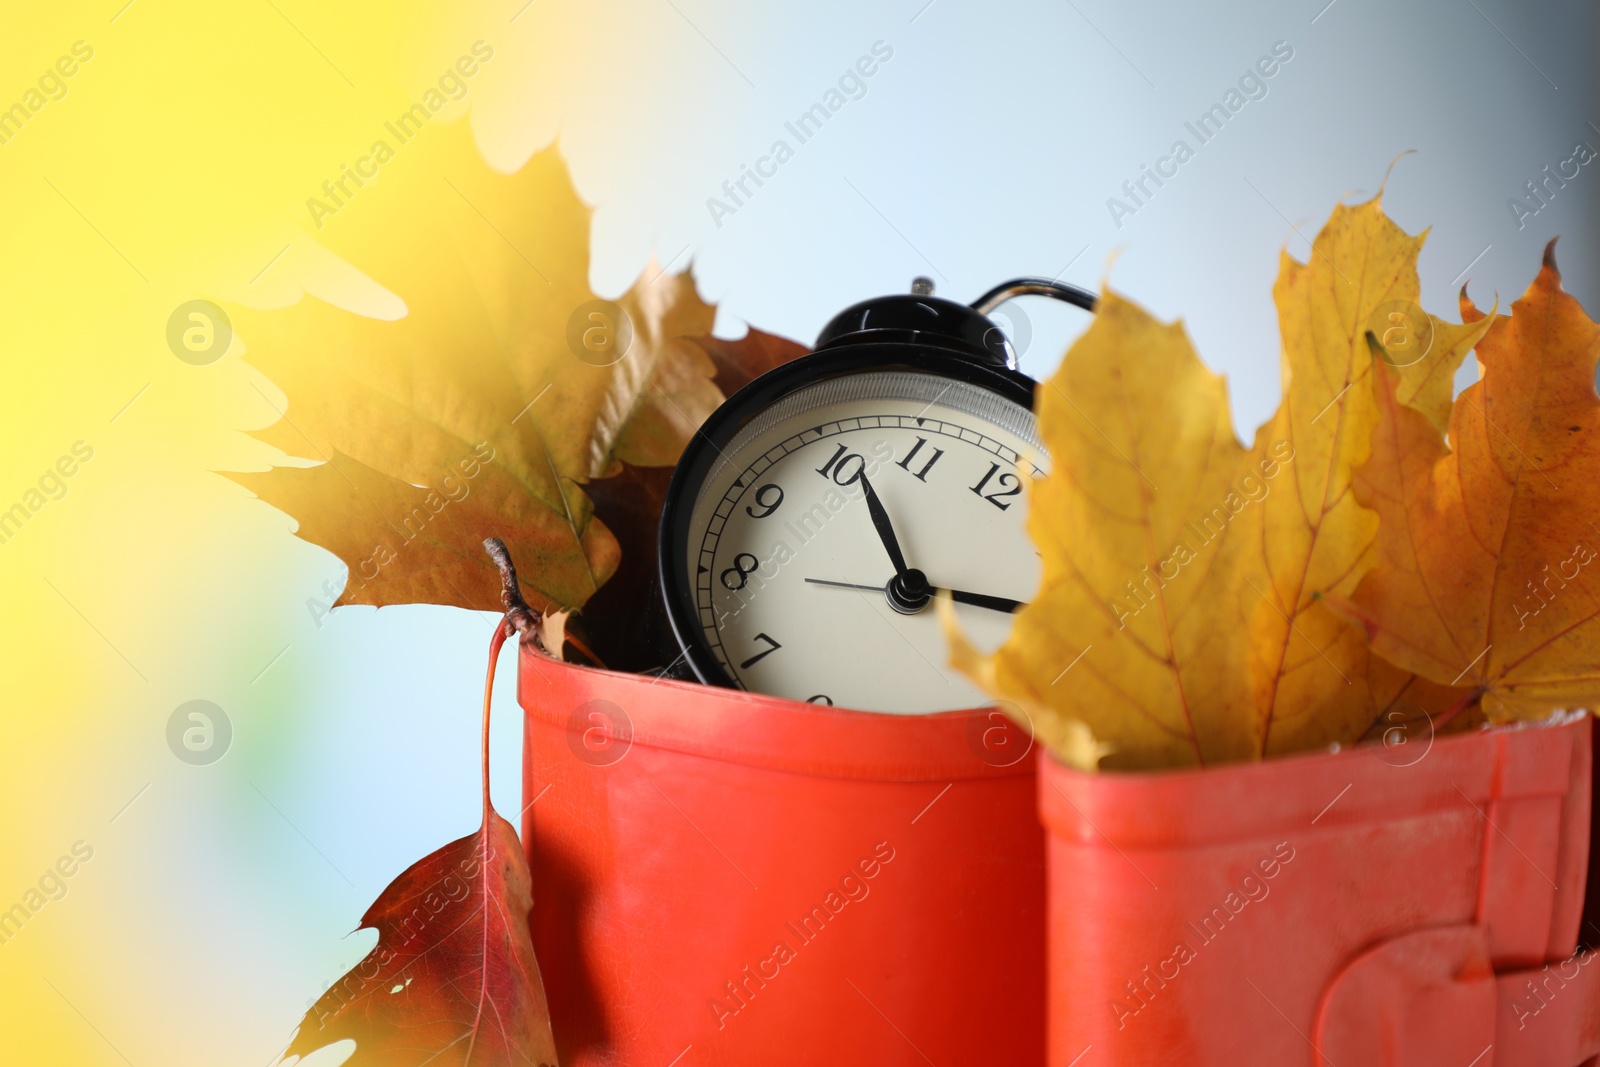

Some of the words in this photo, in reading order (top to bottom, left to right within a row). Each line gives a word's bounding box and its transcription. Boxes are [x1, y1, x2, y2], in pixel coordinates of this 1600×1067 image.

[815, 443, 867, 487] 10
[895, 436, 945, 482] 11
[745, 483, 785, 519] 9
[968, 460, 1024, 511] 12
[720, 553, 759, 591] 8
[740, 633, 782, 669] 7
